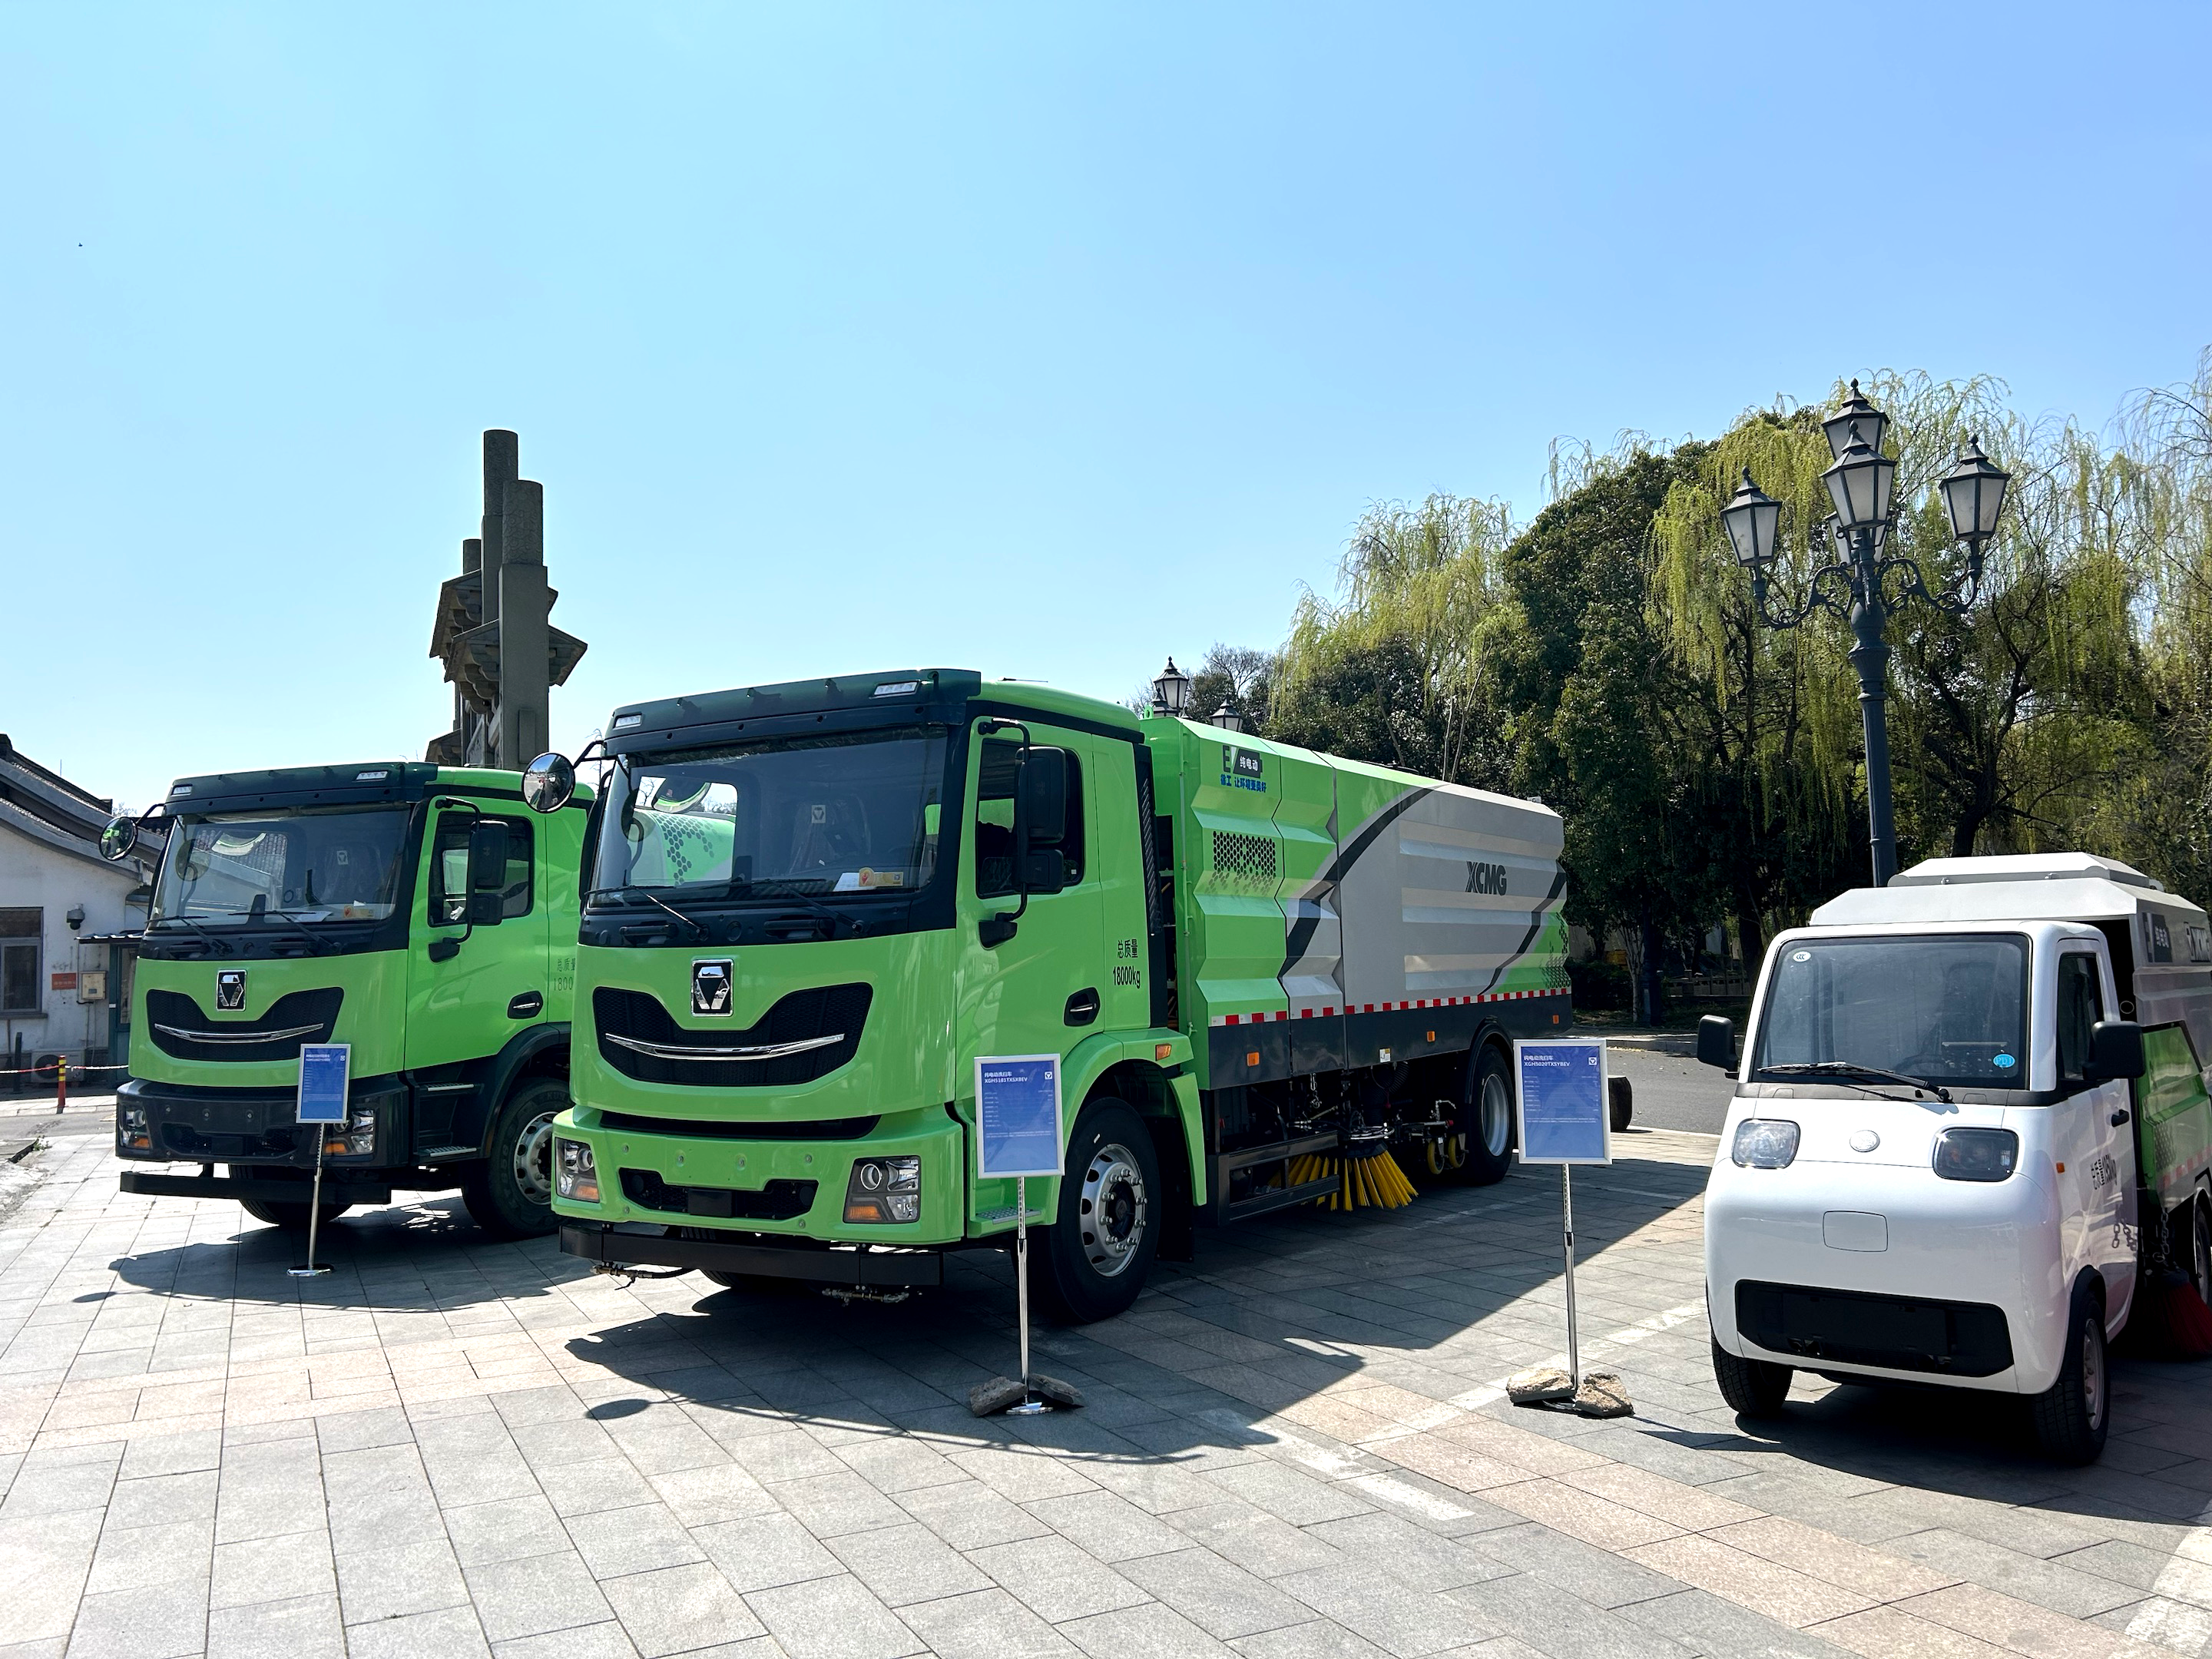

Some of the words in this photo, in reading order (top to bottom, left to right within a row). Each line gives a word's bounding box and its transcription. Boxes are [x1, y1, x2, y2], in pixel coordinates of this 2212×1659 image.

[1240, 756, 1258, 771] 纯电动
[1465, 861, 1507, 896] XCMG
[1118, 939, 1138, 959] 总质量
[554, 976, 574, 991] 1800
[1113, 965, 1141, 989] 18000kg
